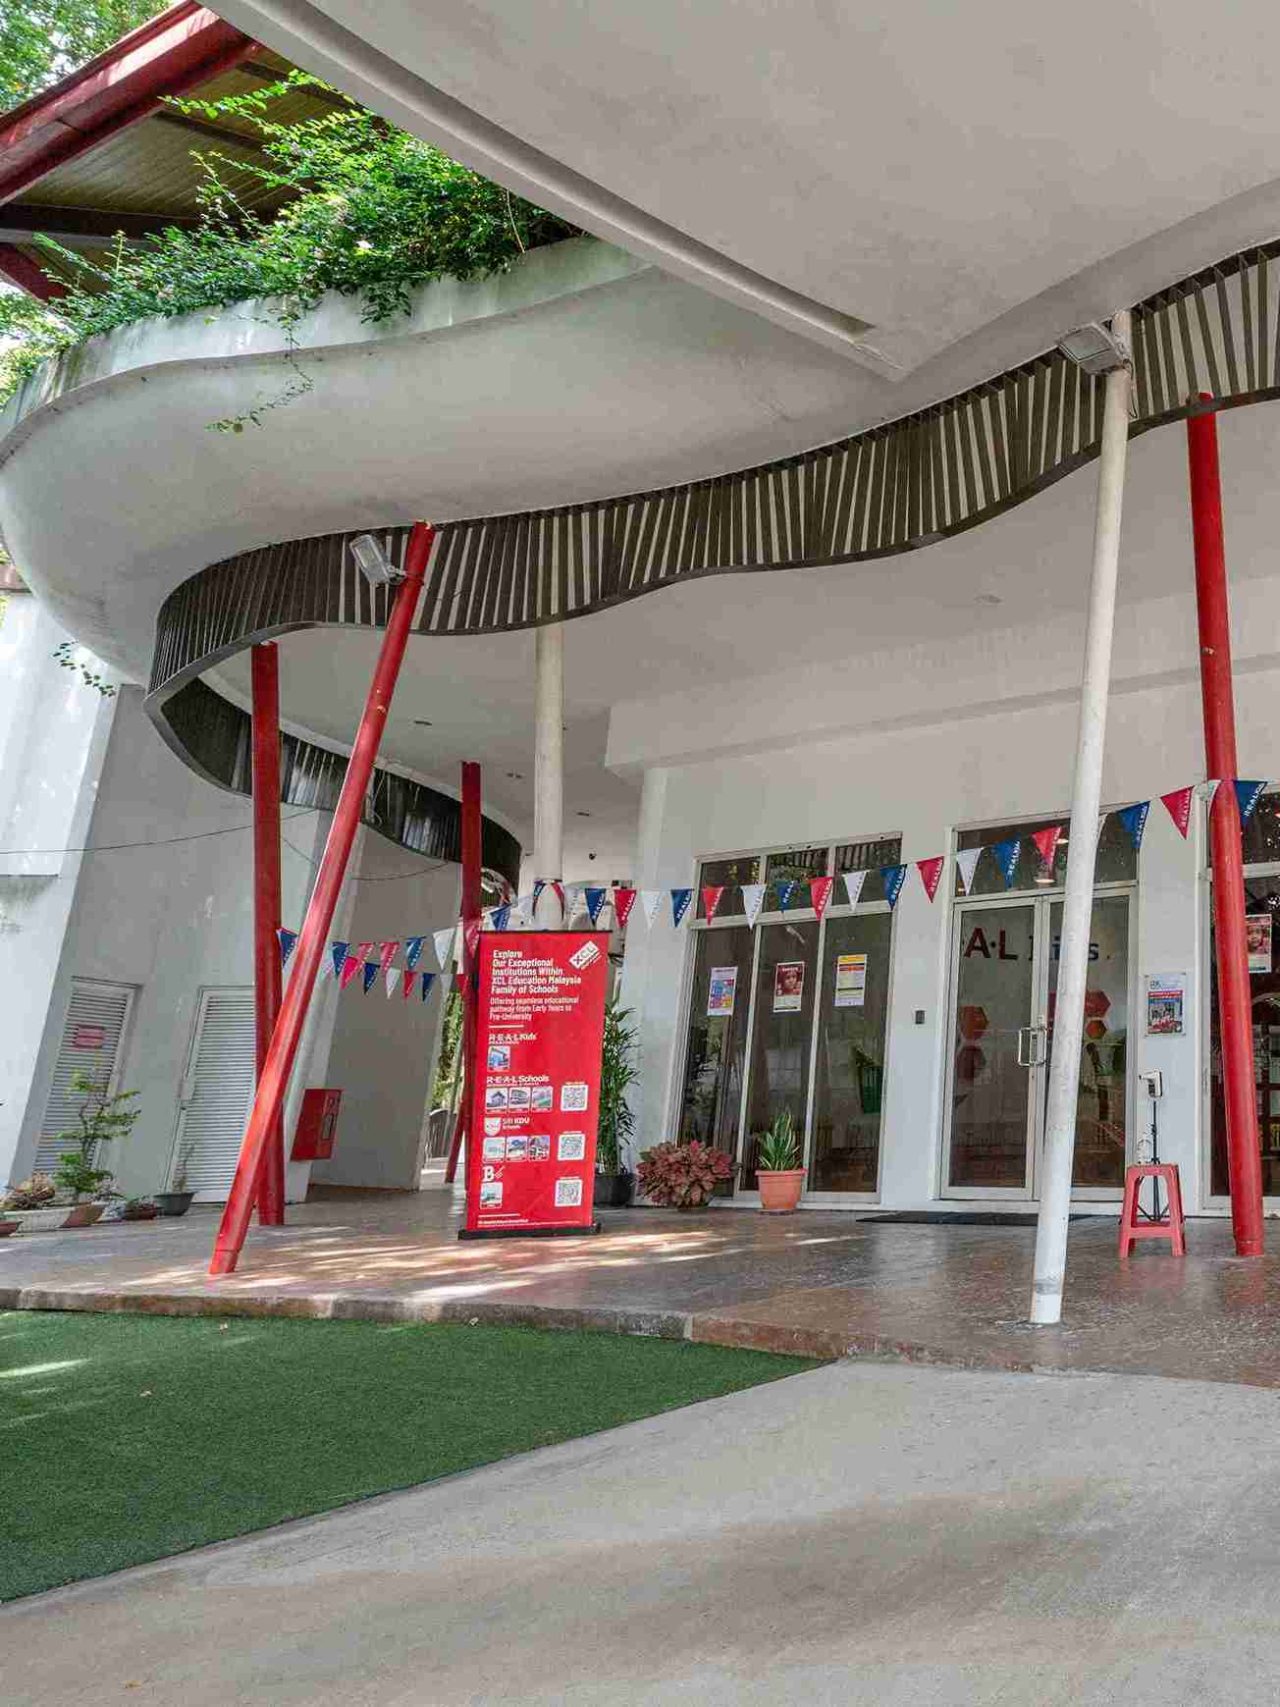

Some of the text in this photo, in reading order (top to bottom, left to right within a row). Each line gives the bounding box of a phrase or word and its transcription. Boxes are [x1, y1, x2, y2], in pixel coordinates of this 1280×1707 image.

[493, 949, 523, 959] Explore
[572, 944, 597, 966] XCL
[492, 958, 553, 969] Our Exceptional
[492, 967, 564, 976] Institutions Within
[491, 976, 582, 987] XCL Education Malaysia
[491, 985, 559, 996] Family of Schools
[490, 997, 515, 1006] Offering
[544, 996, 579, 1004] educational
[532, 1005, 547, 1013] Early
[489, 1012, 533, 1021] Pre-University
